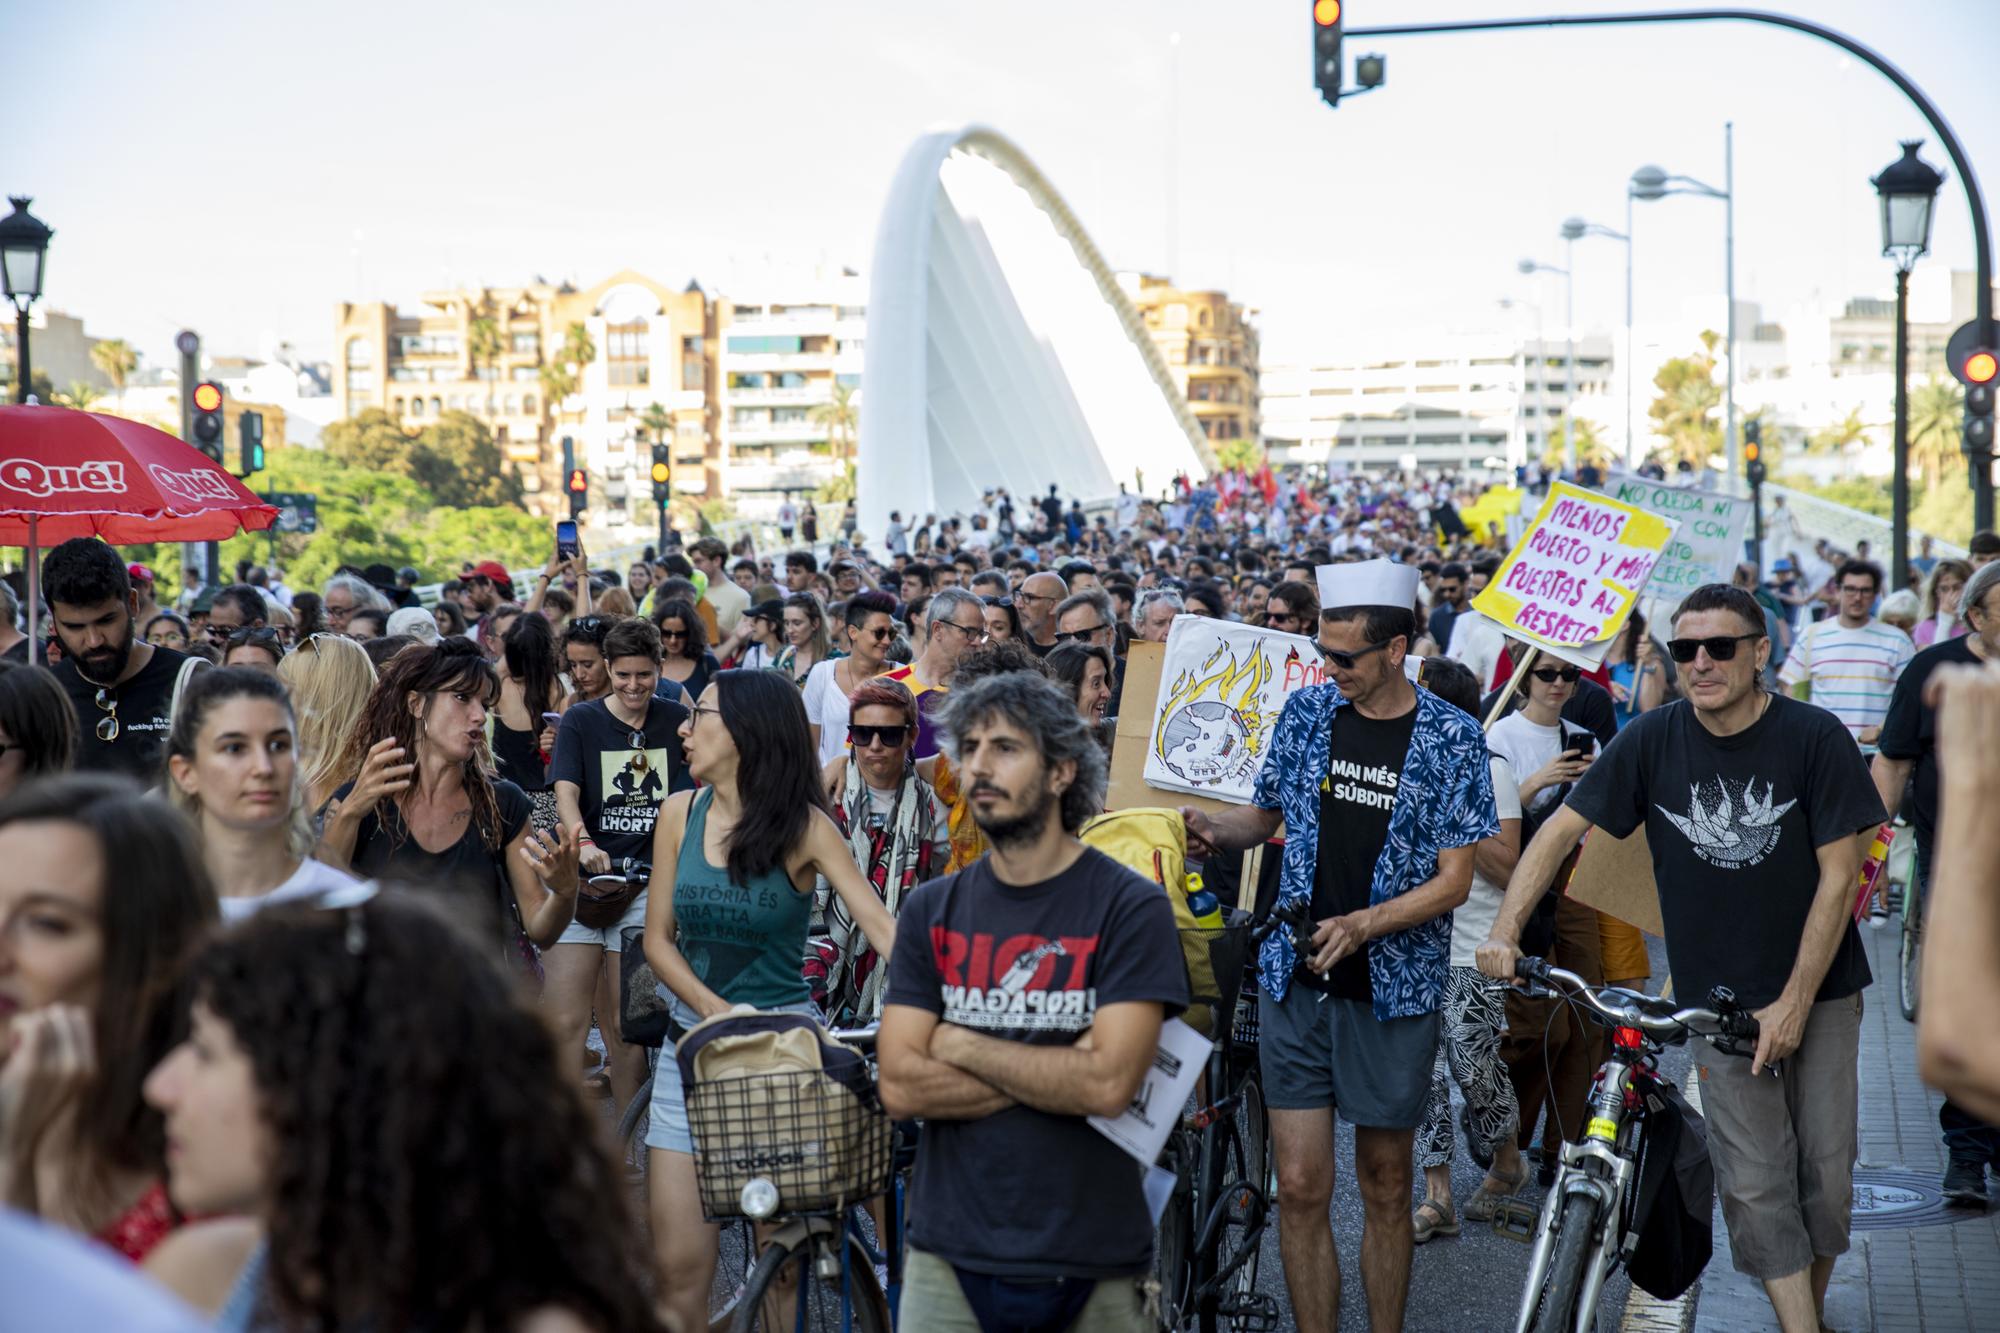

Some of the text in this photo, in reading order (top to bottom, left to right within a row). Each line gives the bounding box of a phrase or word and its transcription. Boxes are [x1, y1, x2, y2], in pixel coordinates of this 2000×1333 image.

[0, 458, 127, 498] Qué!
[148, 463, 240, 502] Qué!
[1616, 482, 1647, 504] NO
[1713, 501, 1732, 518] NI
[1550, 500, 1626, 542] MENOS
[1694, 520, 1730, 539] CON
[1529, 527, 1591, 565] PUERTO
[1594, 552, 1614, 575] Y
[1505, 561, 1617, 615] PUERTAS AL
[1331, 759, 1398, 788] MAI MÉS
[674, 883, 778, 909] HISTÒRIA ÉS
[929, 925, 1099, 995] RIOT
